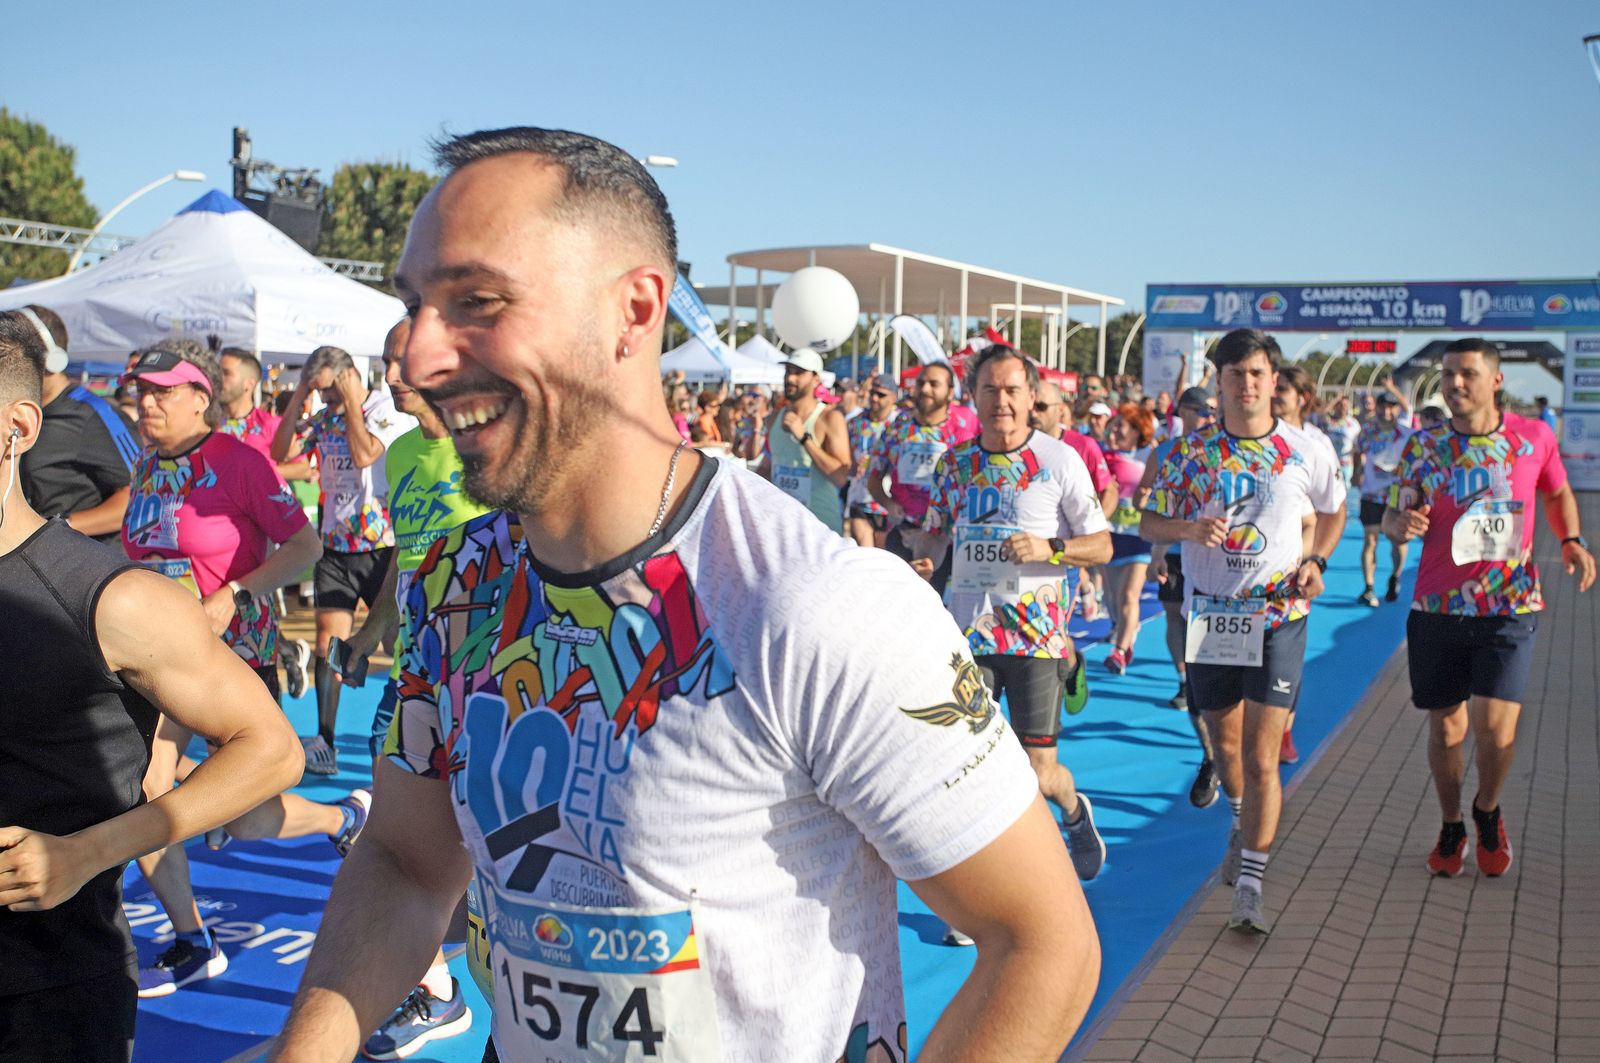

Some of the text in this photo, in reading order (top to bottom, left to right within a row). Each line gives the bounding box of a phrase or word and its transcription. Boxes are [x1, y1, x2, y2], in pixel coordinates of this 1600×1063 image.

[1301, 287, 1409, 301] CAMPEONATO
[1300, 299, 1447, 318] de ESPAÑA 10 km
[911, 453, 933, 465] 715
[1226, 557, 1260, 569] WiHu
[1203, 615, 1252, 634] 1855
[587, 927, 671, 962] 2023
[541, 948, 572, 964] WiHu
[501, 957, 664, 1057] 1574
